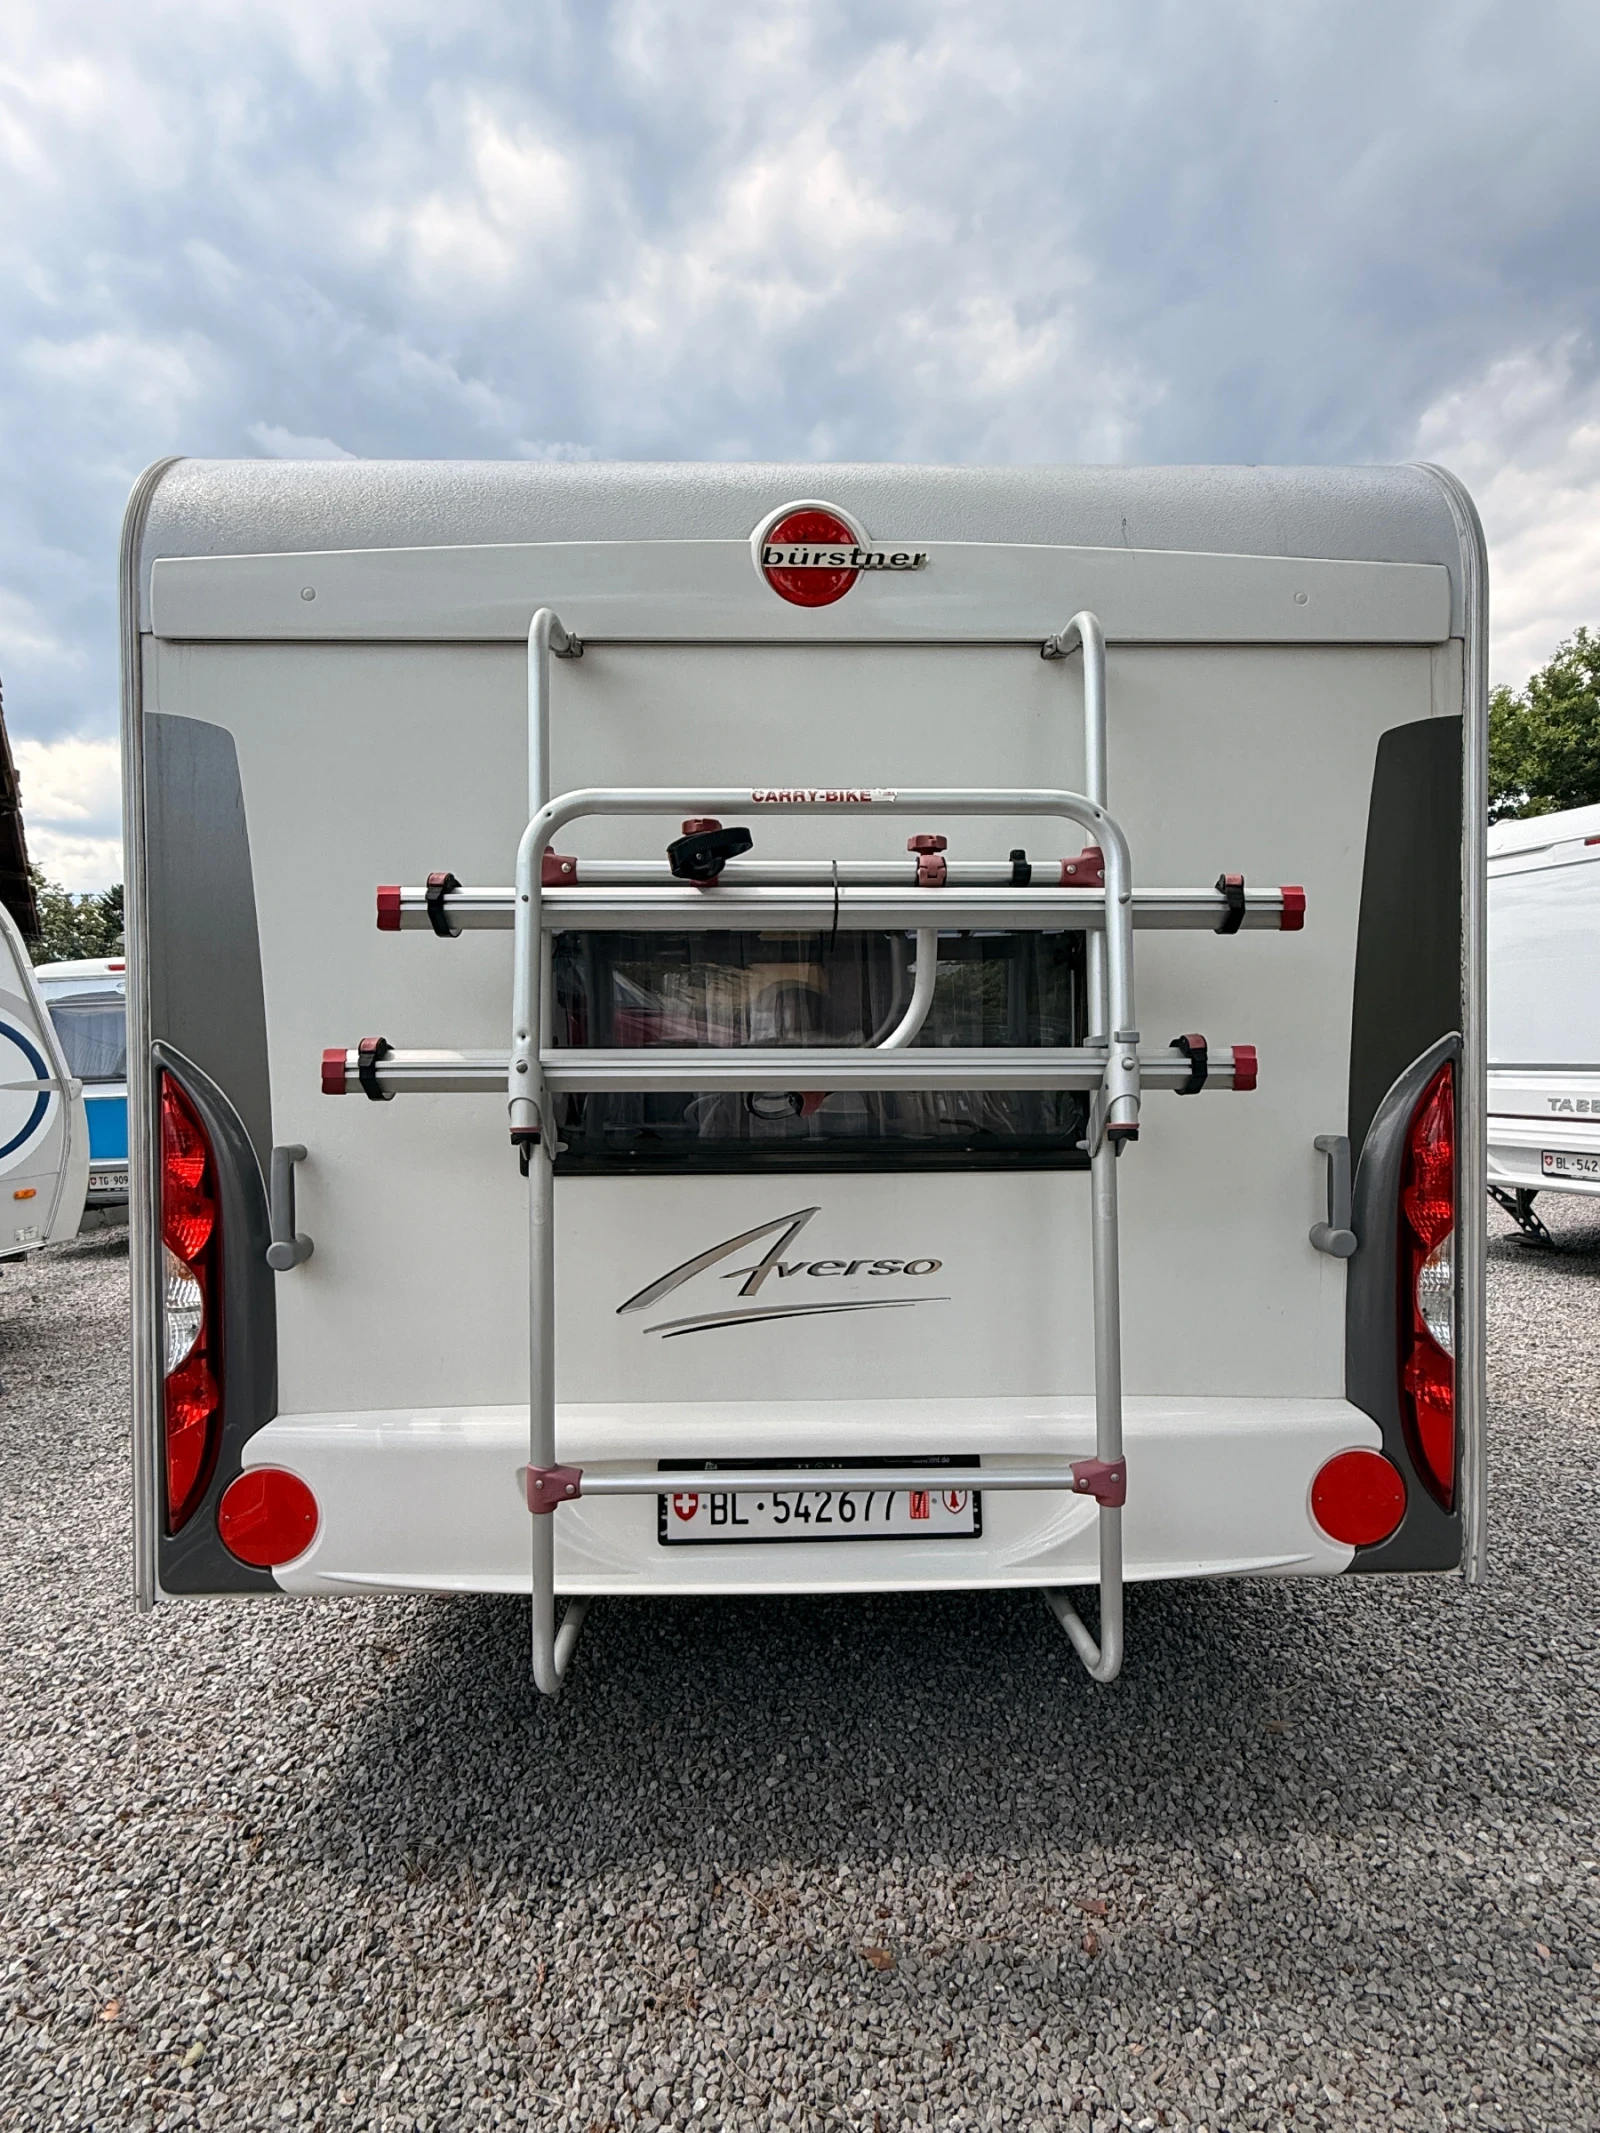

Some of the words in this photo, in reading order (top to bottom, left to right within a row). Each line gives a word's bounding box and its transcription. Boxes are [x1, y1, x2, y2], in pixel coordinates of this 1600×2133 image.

[762, 546, 928, 568] bürstner
[752, 790, 872, 802] CARRY-BIKE
[616, 1206, 943, 1314] Averso
